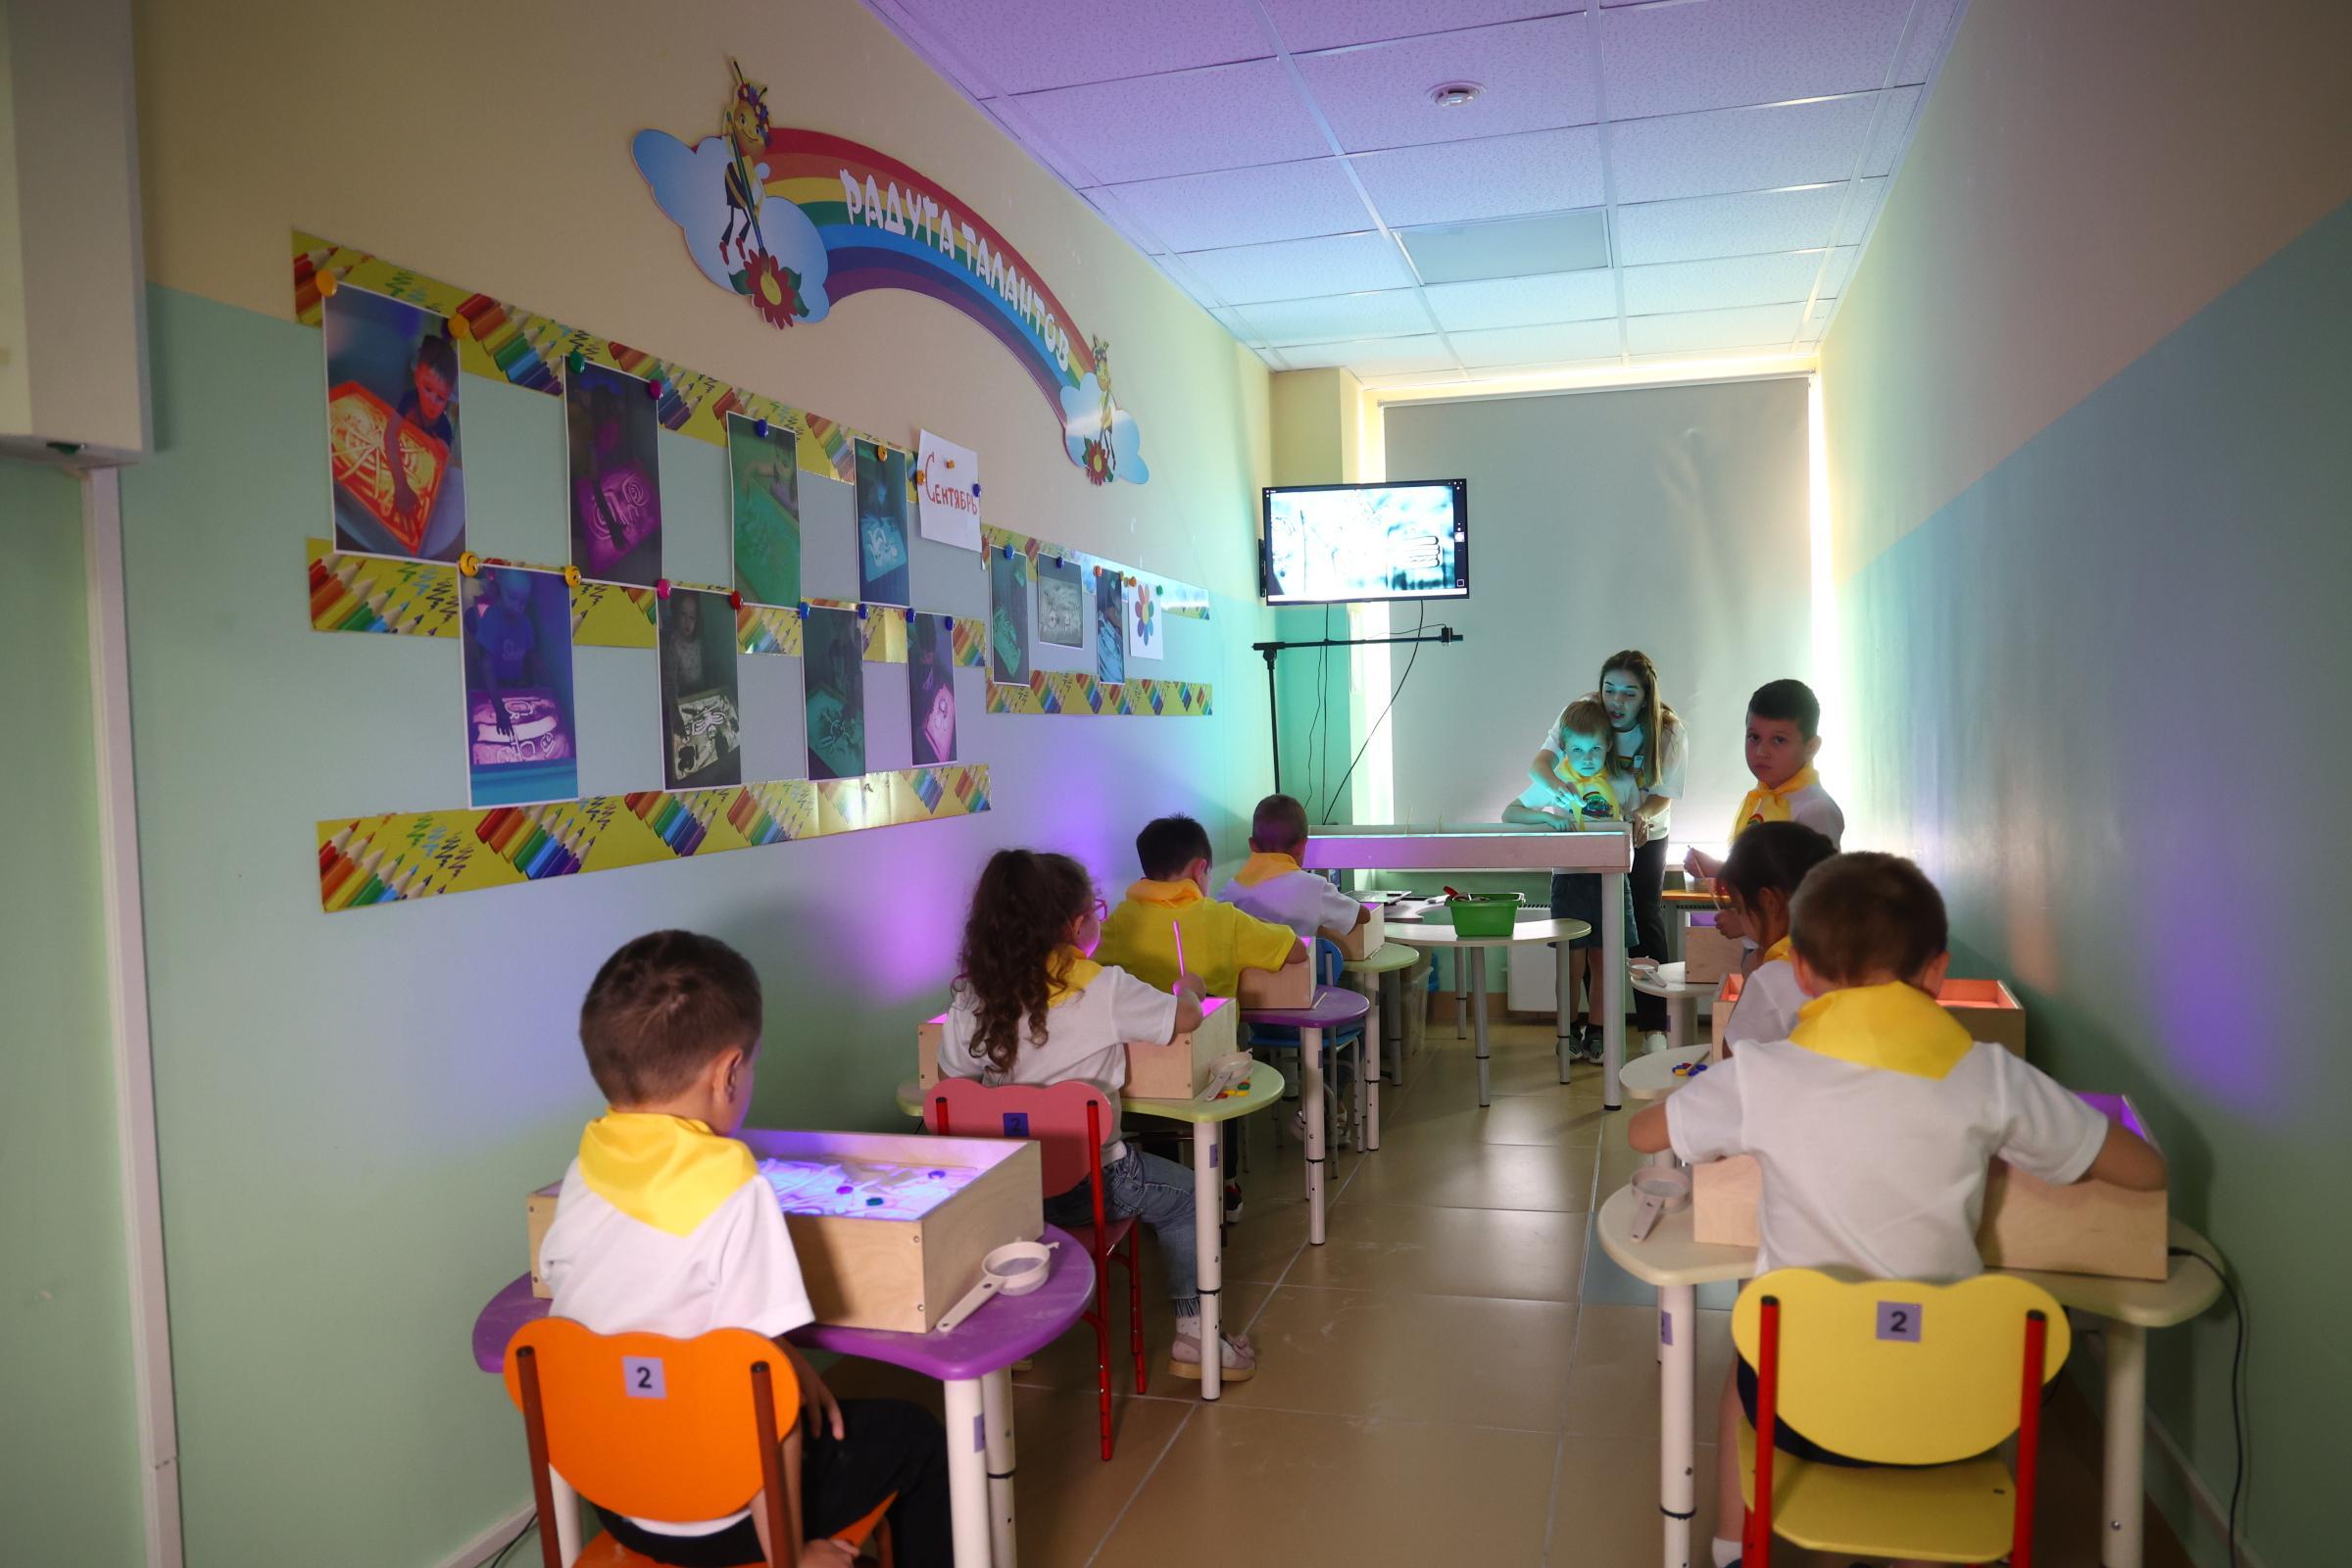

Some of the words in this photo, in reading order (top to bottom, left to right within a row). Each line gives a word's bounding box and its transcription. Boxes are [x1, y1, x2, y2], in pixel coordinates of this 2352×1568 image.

[839, 168, 956, 260] РАДУГА
[960, 220, 1070, 372] ТАЛАНТОВ
[1010, 1117, 1022, 1132] 2
[1890, 1310, 1908, 1333] 2
[636, 1366, 653, 1389] 2
